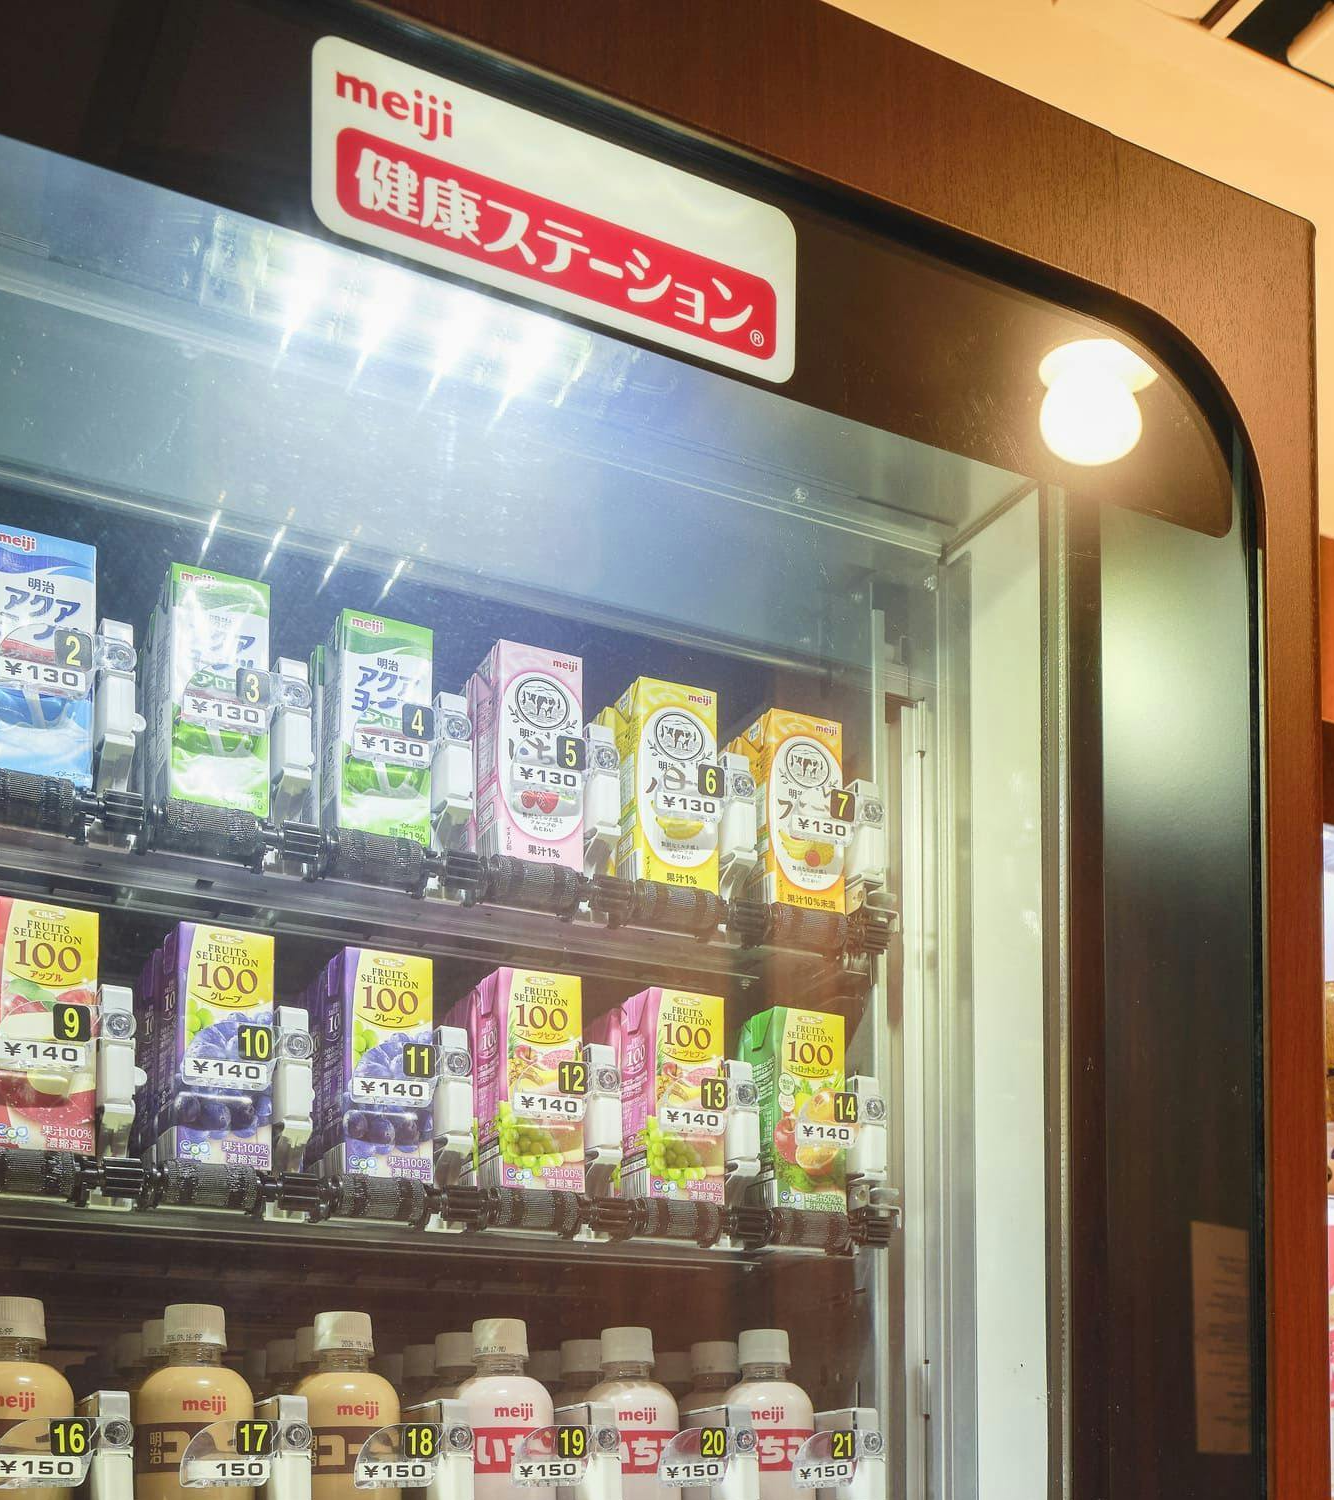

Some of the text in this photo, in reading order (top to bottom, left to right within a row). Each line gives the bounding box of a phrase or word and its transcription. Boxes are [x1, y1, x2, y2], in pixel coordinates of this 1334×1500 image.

[335, 71, 453, 141] meiji
[64, 636, 81, 666] 2
[4, 660, 78, 688] ¥130
[553, 659, 578, 672] meiji
[245, 674, 260, 702] 3
[688, 693, 712, 705] meiji
[191, 699, 259, 724] ¥130
[411, 709, 424, 737] 4
[816, 724, 837, 736] meiji
[362, 735, 424, 757] ¥130
[565, 741, 577, 766] 5
[519, 766, 577, 787] ¥130
[705, 768, 717, 793] 6
[662, 795, 716, 814] ¥130
[836, 793, 848, 817] 7
[798, 818, 846, 836] ¥130
[528, 845, 560, 859] 果汁1%
[14, 940, 82, 973] 100
[197, 962, 258, 995] 100
[210, 991, 242, 1004] グレープ
[64, 1007, 79, 1038] 9
[4, 1041, 78, 1062] ¥140
[242, 1028, 269, 1059] 10
[192, 1059, 261, 1079] ¥140
[406, 1046, 430, 1076] 11
[360, 1080, 423, 1098] ¥140
[561, 1064, 585, 1092] 12
[520, 1095, 578, 1114] ¥140
[703, 1081, 725, 1108] 13
[665, 1109, 719, 1127] ¥140
[836, 1094, 857, 1121] 14
[802, 1125, 849, 1141] ¥140
[182, 1395, 227, 1415] meiji
[54, 1422, 85, 1453] 16
[240, 1424, 268, 1453] 17
[407, 1427, 433, 1456] 18
[560, 1428, 584, 1456] 19
[702, 1429, 725, 1457] 20
[833, 1432, 854, 1458] 21
[0, 1460, 74, 1476] ¥150
[364, 1464, 426, 1478] ¥150
[519, 1463, 577, 1478] ¥150
[666, 1463, 719, 1479] ¥150
[799, 1463, 848, 1480] ¥150
